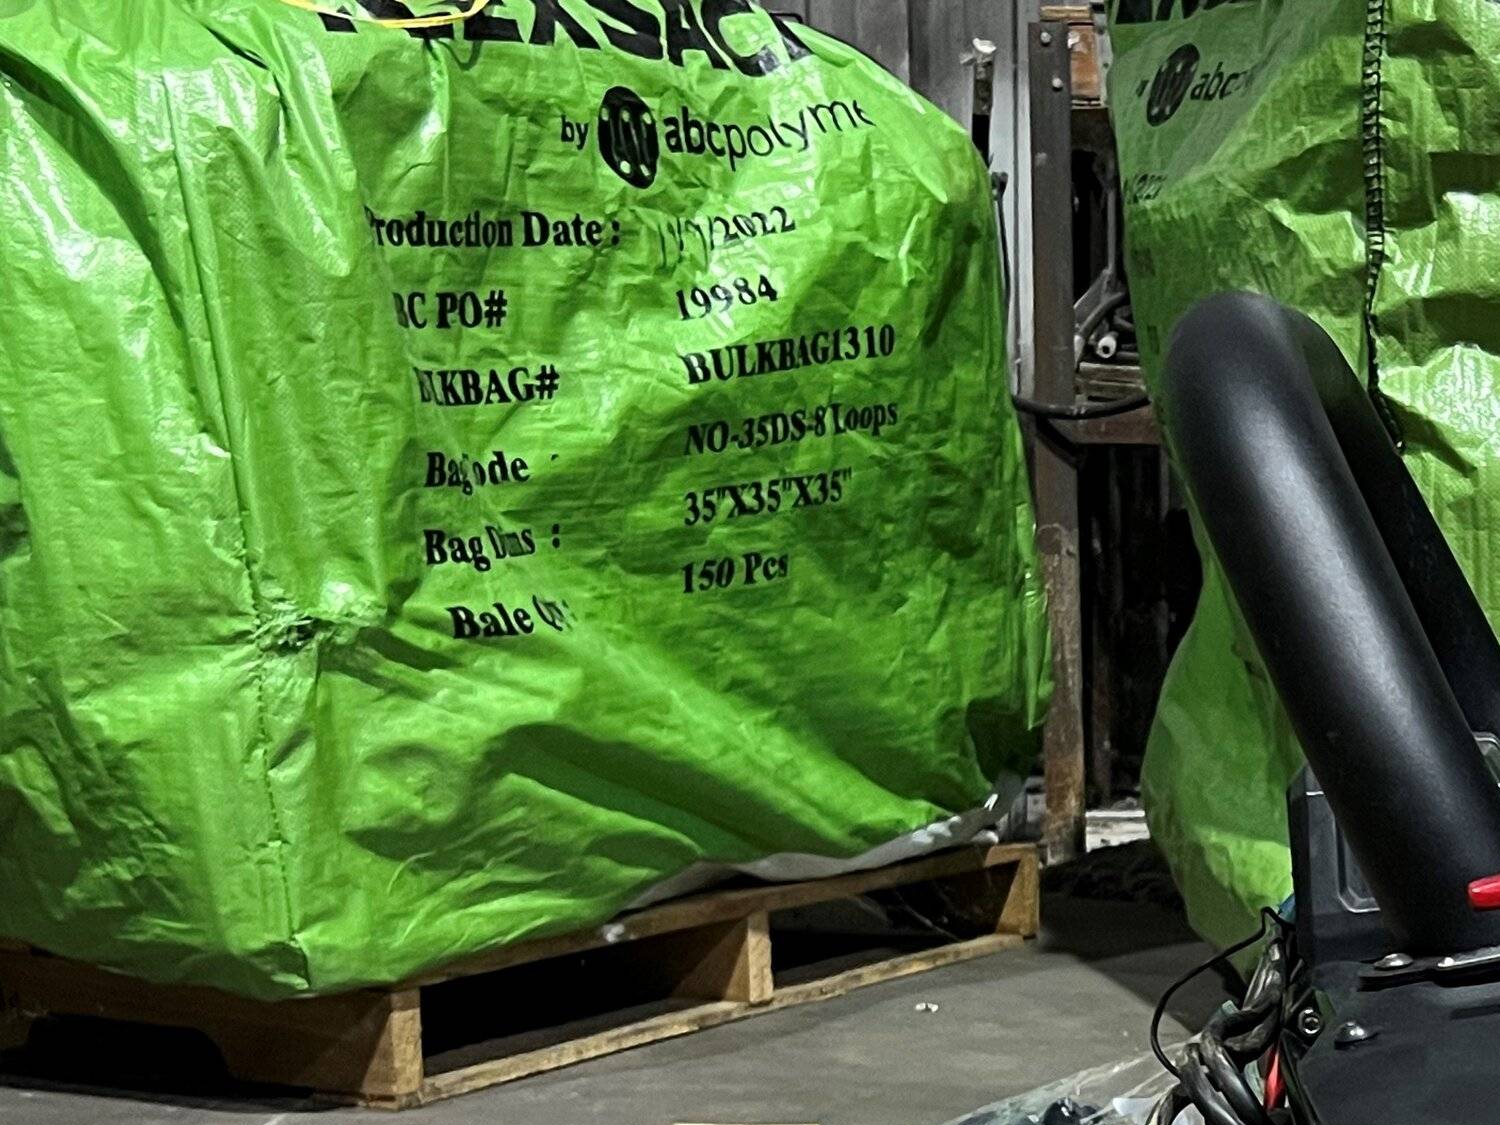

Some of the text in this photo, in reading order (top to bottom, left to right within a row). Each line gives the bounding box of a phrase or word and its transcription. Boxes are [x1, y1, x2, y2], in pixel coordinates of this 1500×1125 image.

[560, 115, 588, 150] by
[520, 211, 602, 248] Date
[435, 289, 508, 329] PO#
[676, 274, 778, 320] 19984
[681, 324, 895, 384] BULKBAG1310
[828, 402, 898, 437] Loops
[424, 529, 491, 572] Bag
[446, 603, 535, 639] Bale
[682, 557, 735, 593] 150
[743, 552, 788, 585] Pcs
